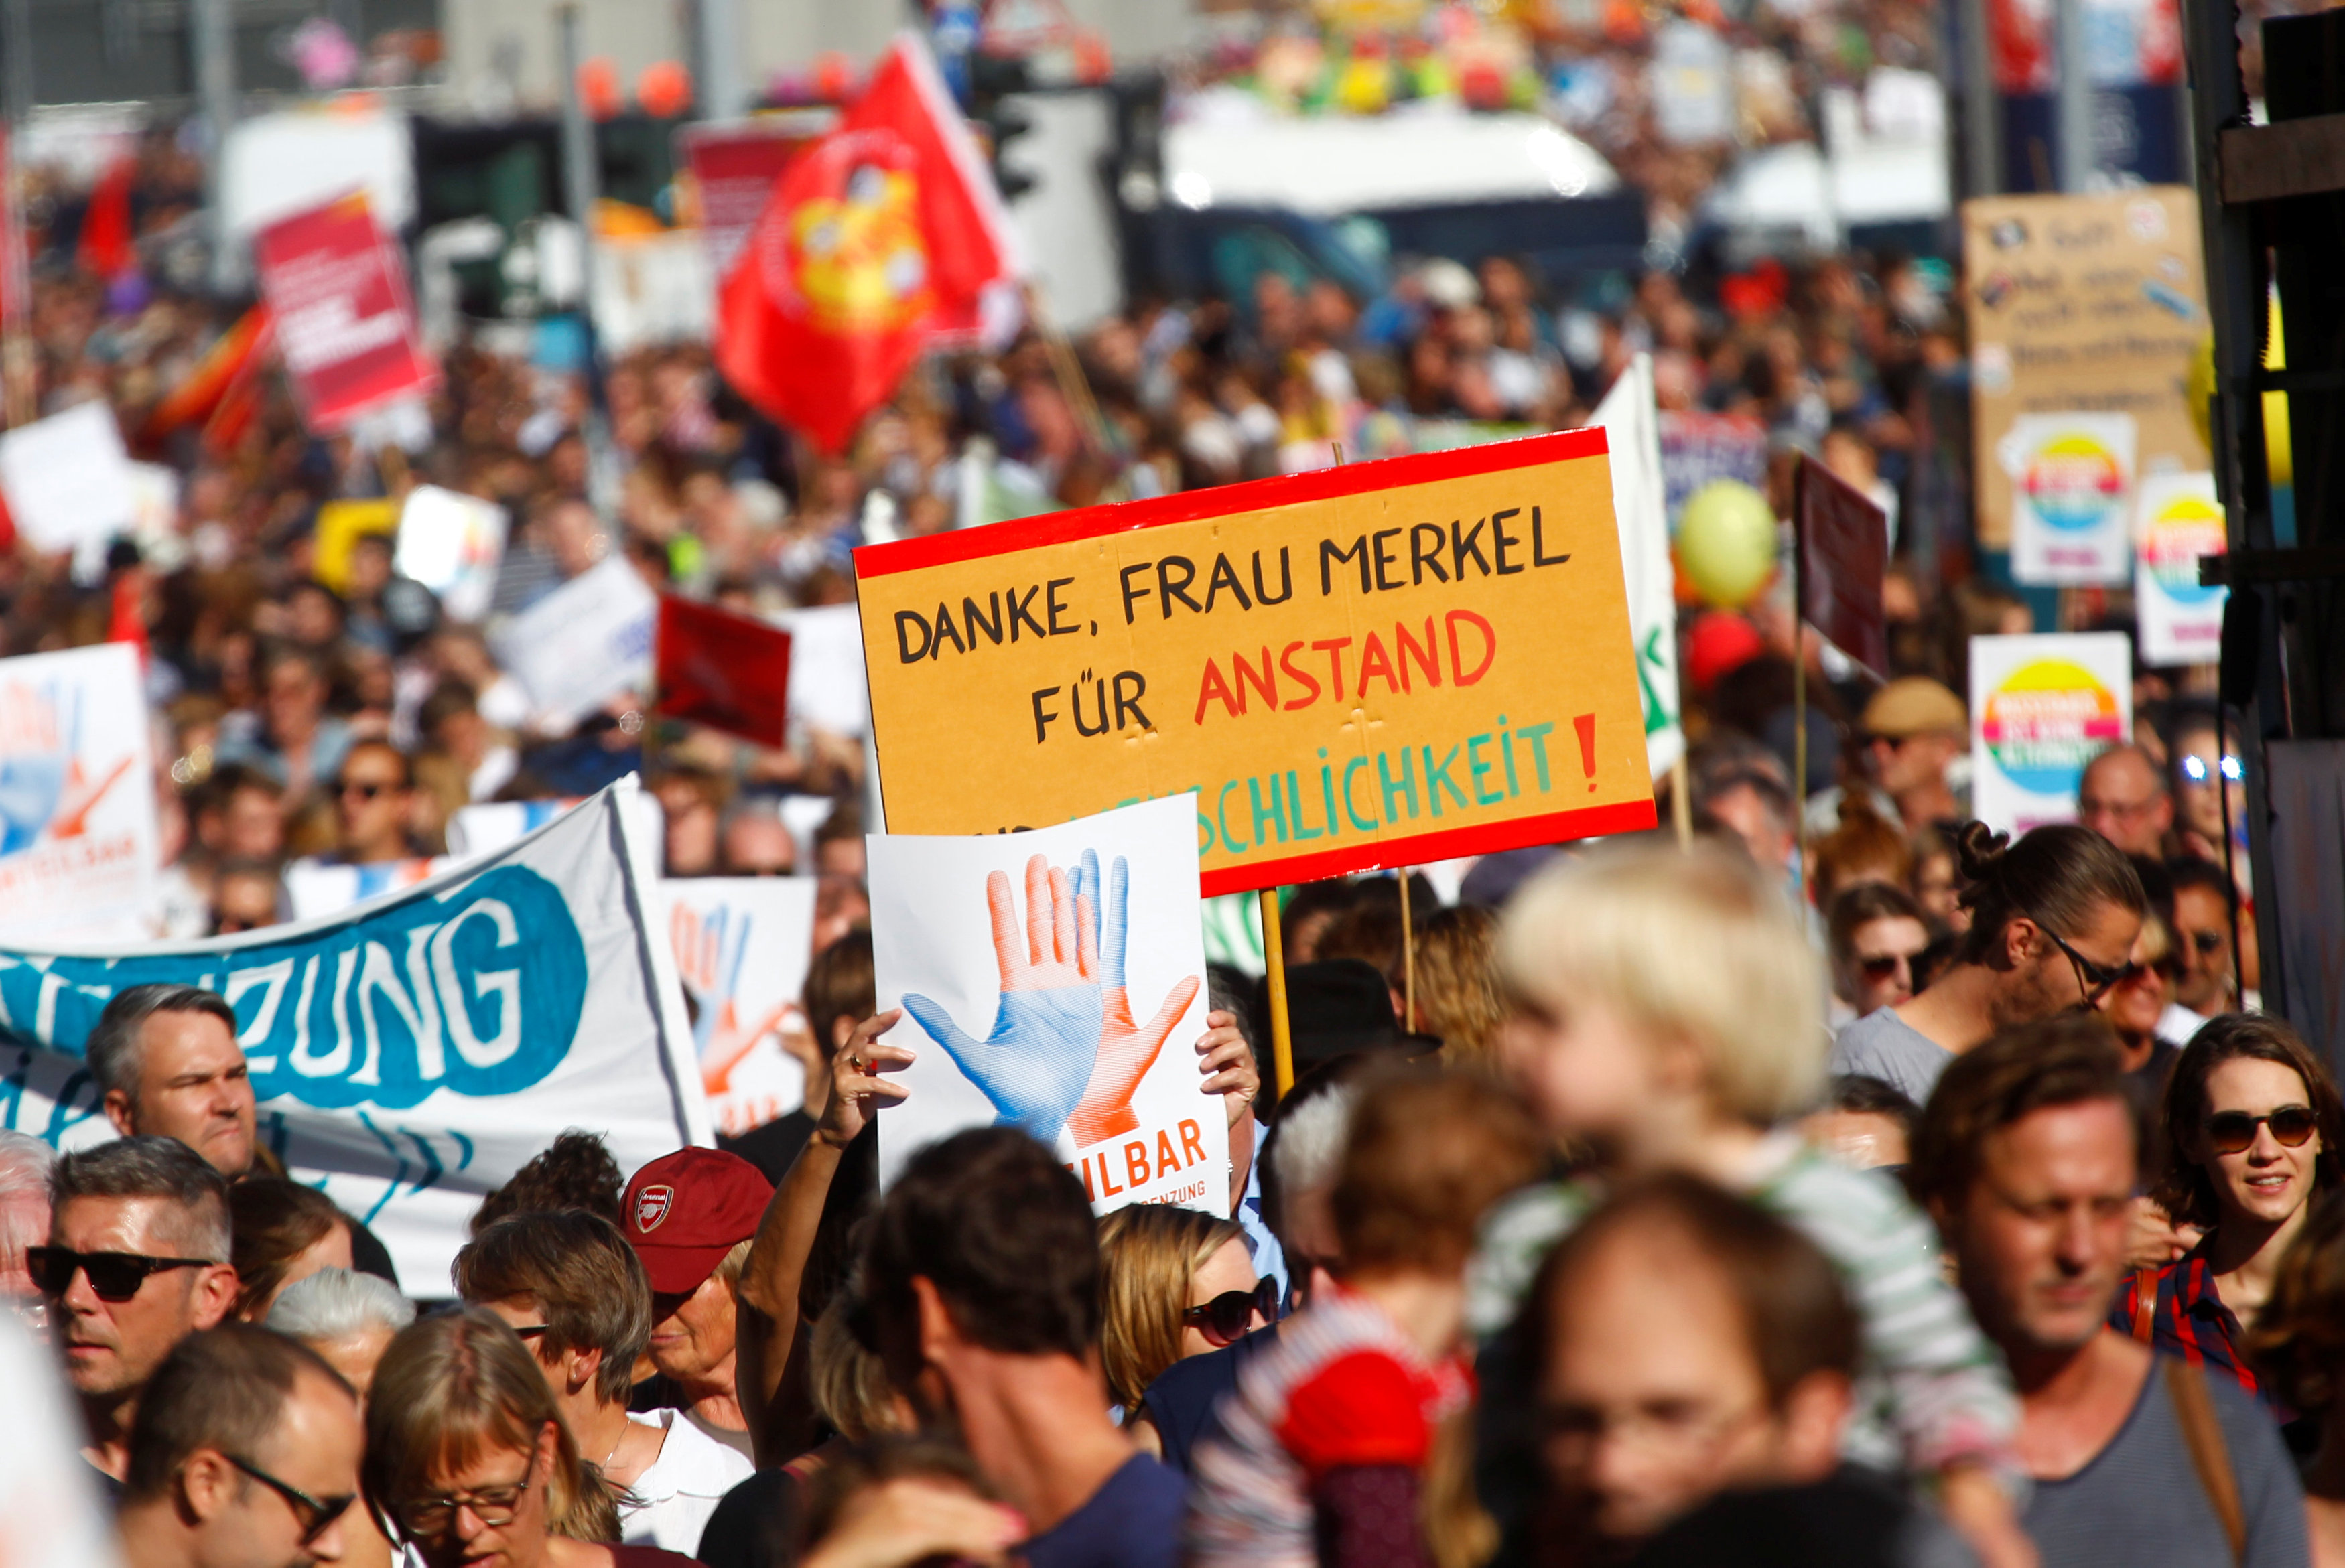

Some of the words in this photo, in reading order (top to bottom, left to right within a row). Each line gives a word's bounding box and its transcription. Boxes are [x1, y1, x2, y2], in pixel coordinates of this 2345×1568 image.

[894, 577, 1098, 664] DANKE,
[1119, 547, 1293, 625] FRAU
[1320, 506, 1571, 595] MERKEL
[1032, 669, 1152, 744] FÜR
[1195, 610, 1496, 726] ANSTAND
[641, 1193, 666, 1201] Arsenal
[1062, 1118, 1207, 1204] ILBAR
